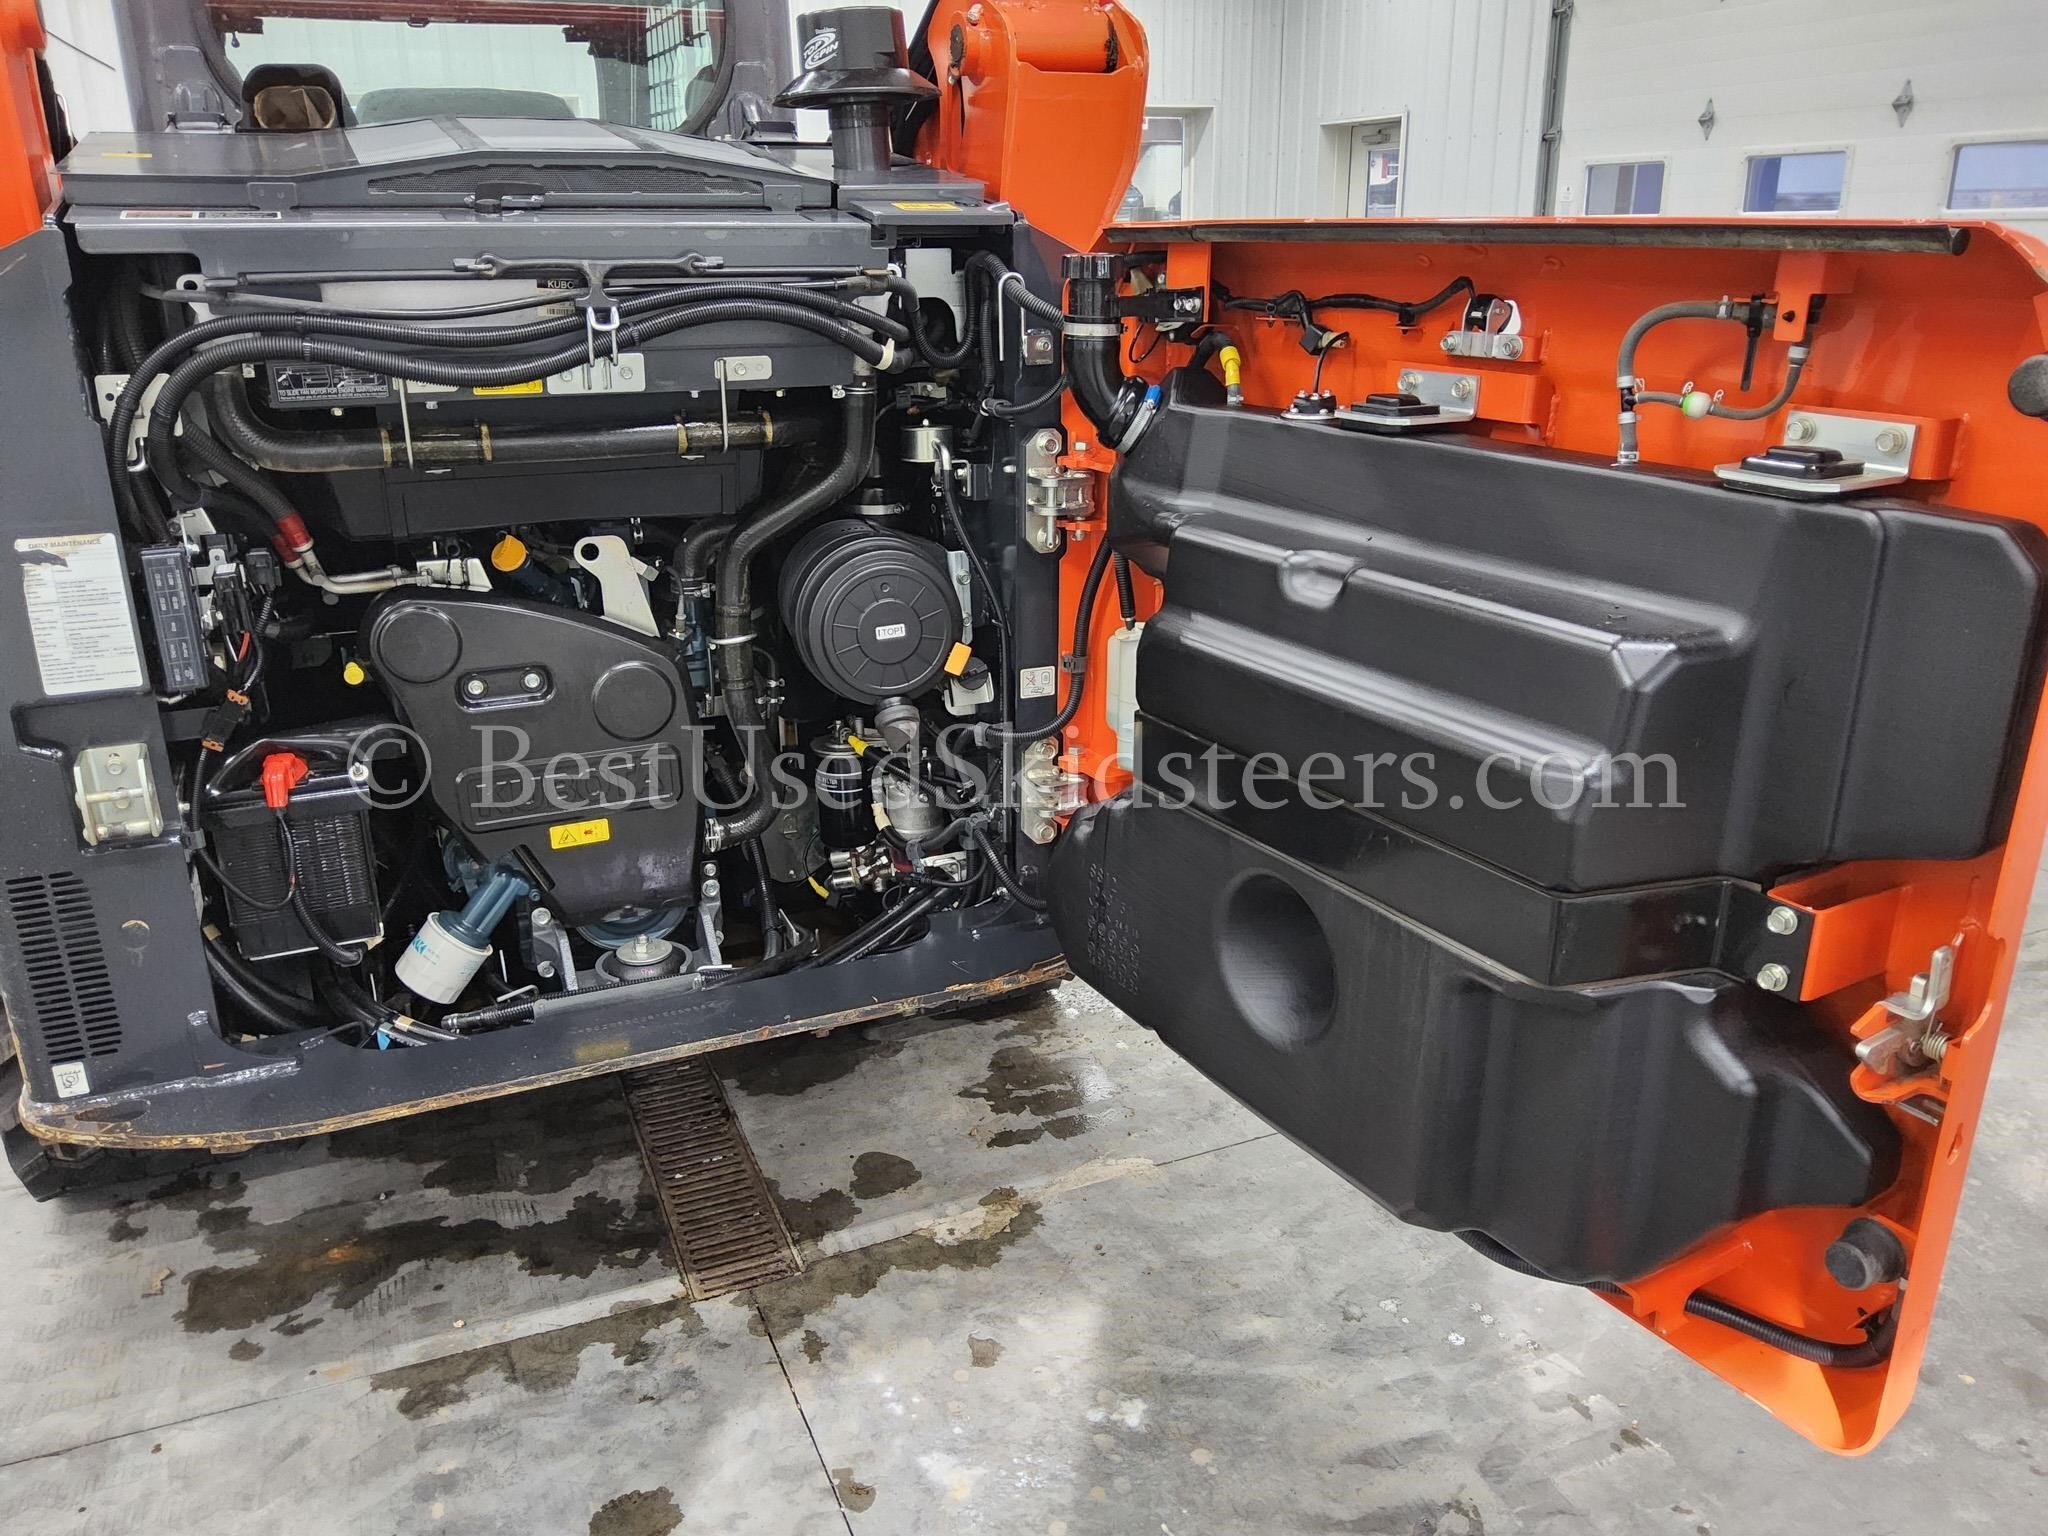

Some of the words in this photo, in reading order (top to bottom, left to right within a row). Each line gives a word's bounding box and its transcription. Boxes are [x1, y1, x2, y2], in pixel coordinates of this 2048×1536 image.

[803, 40, 822, 59] TOP
[813, 41, 839, 62] SPIN
[310, 387, 327, 395] MOTOR
